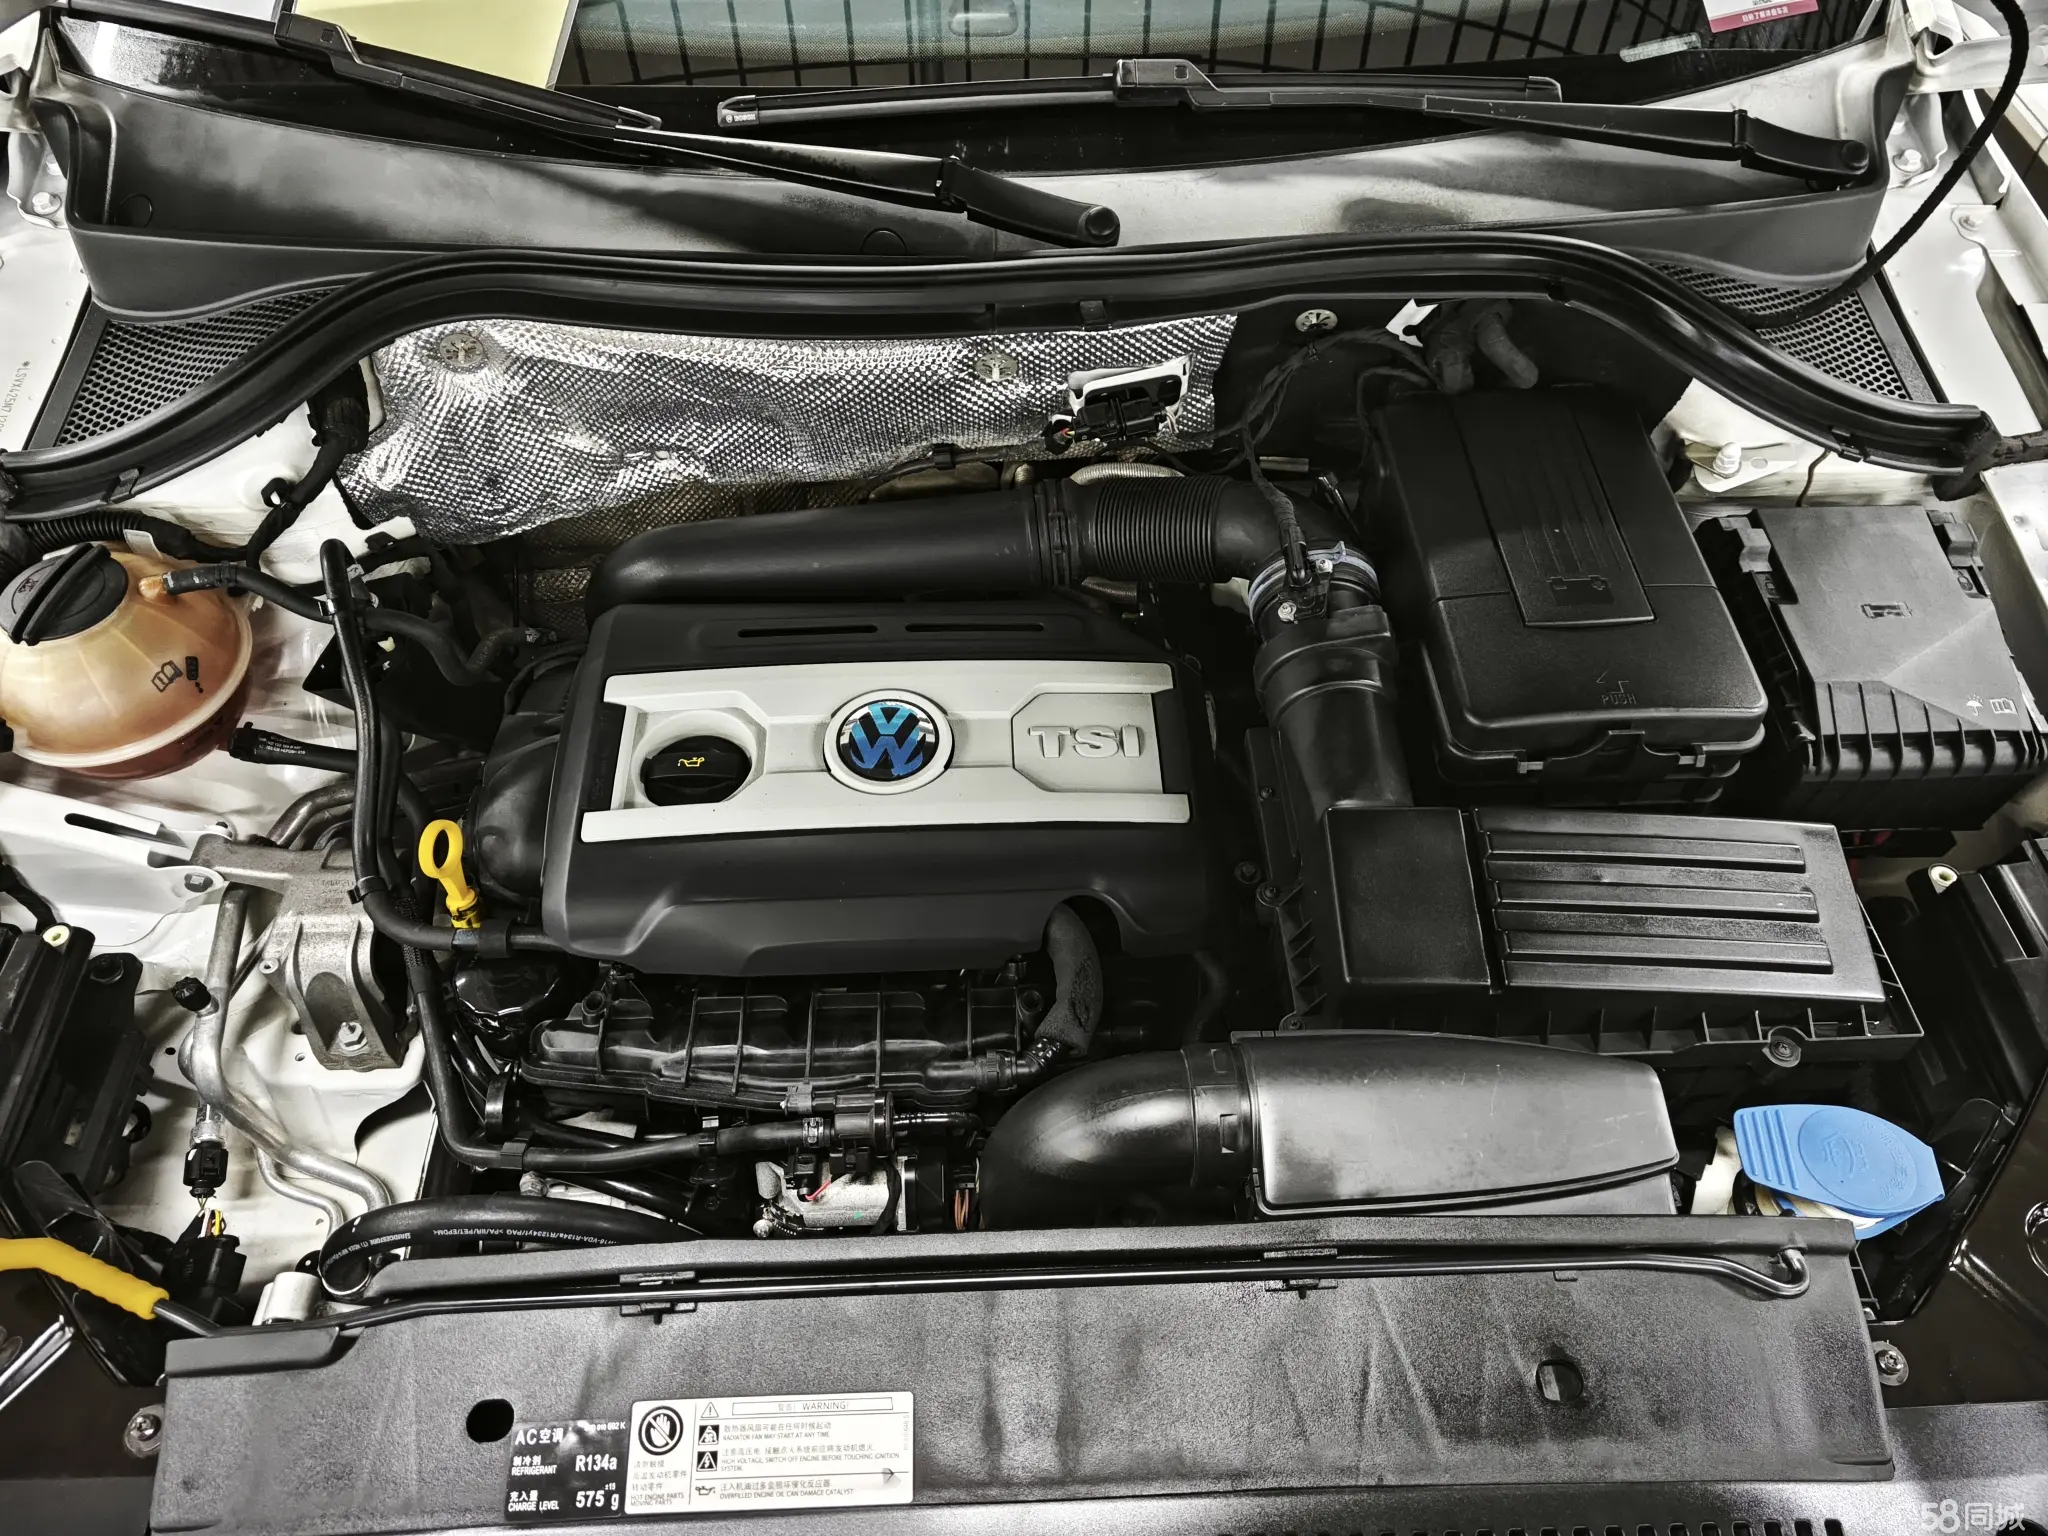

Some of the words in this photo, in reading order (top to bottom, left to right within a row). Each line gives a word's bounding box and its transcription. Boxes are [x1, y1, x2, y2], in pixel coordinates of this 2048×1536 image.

[1602, 694, 1636, 704] PUSH
[1028, 725, 1144, 758] TSI
[802, 1401, 849, 1410] WARNING!
[575, 1454, 617, 1472] R134a
[512, 1465, 557, 1476] REFRIGERANT
[510, 1490, 538, 1502] 充入量
[576, 1490, 605, 1508] 575
[611, 1493, 619, 1510] g
[720, 1492, 752, 1500] OVERFILLED
[508, 1501, 536, 1512] CHARGE
[539, 1500, 559, 1510] LEVEL
